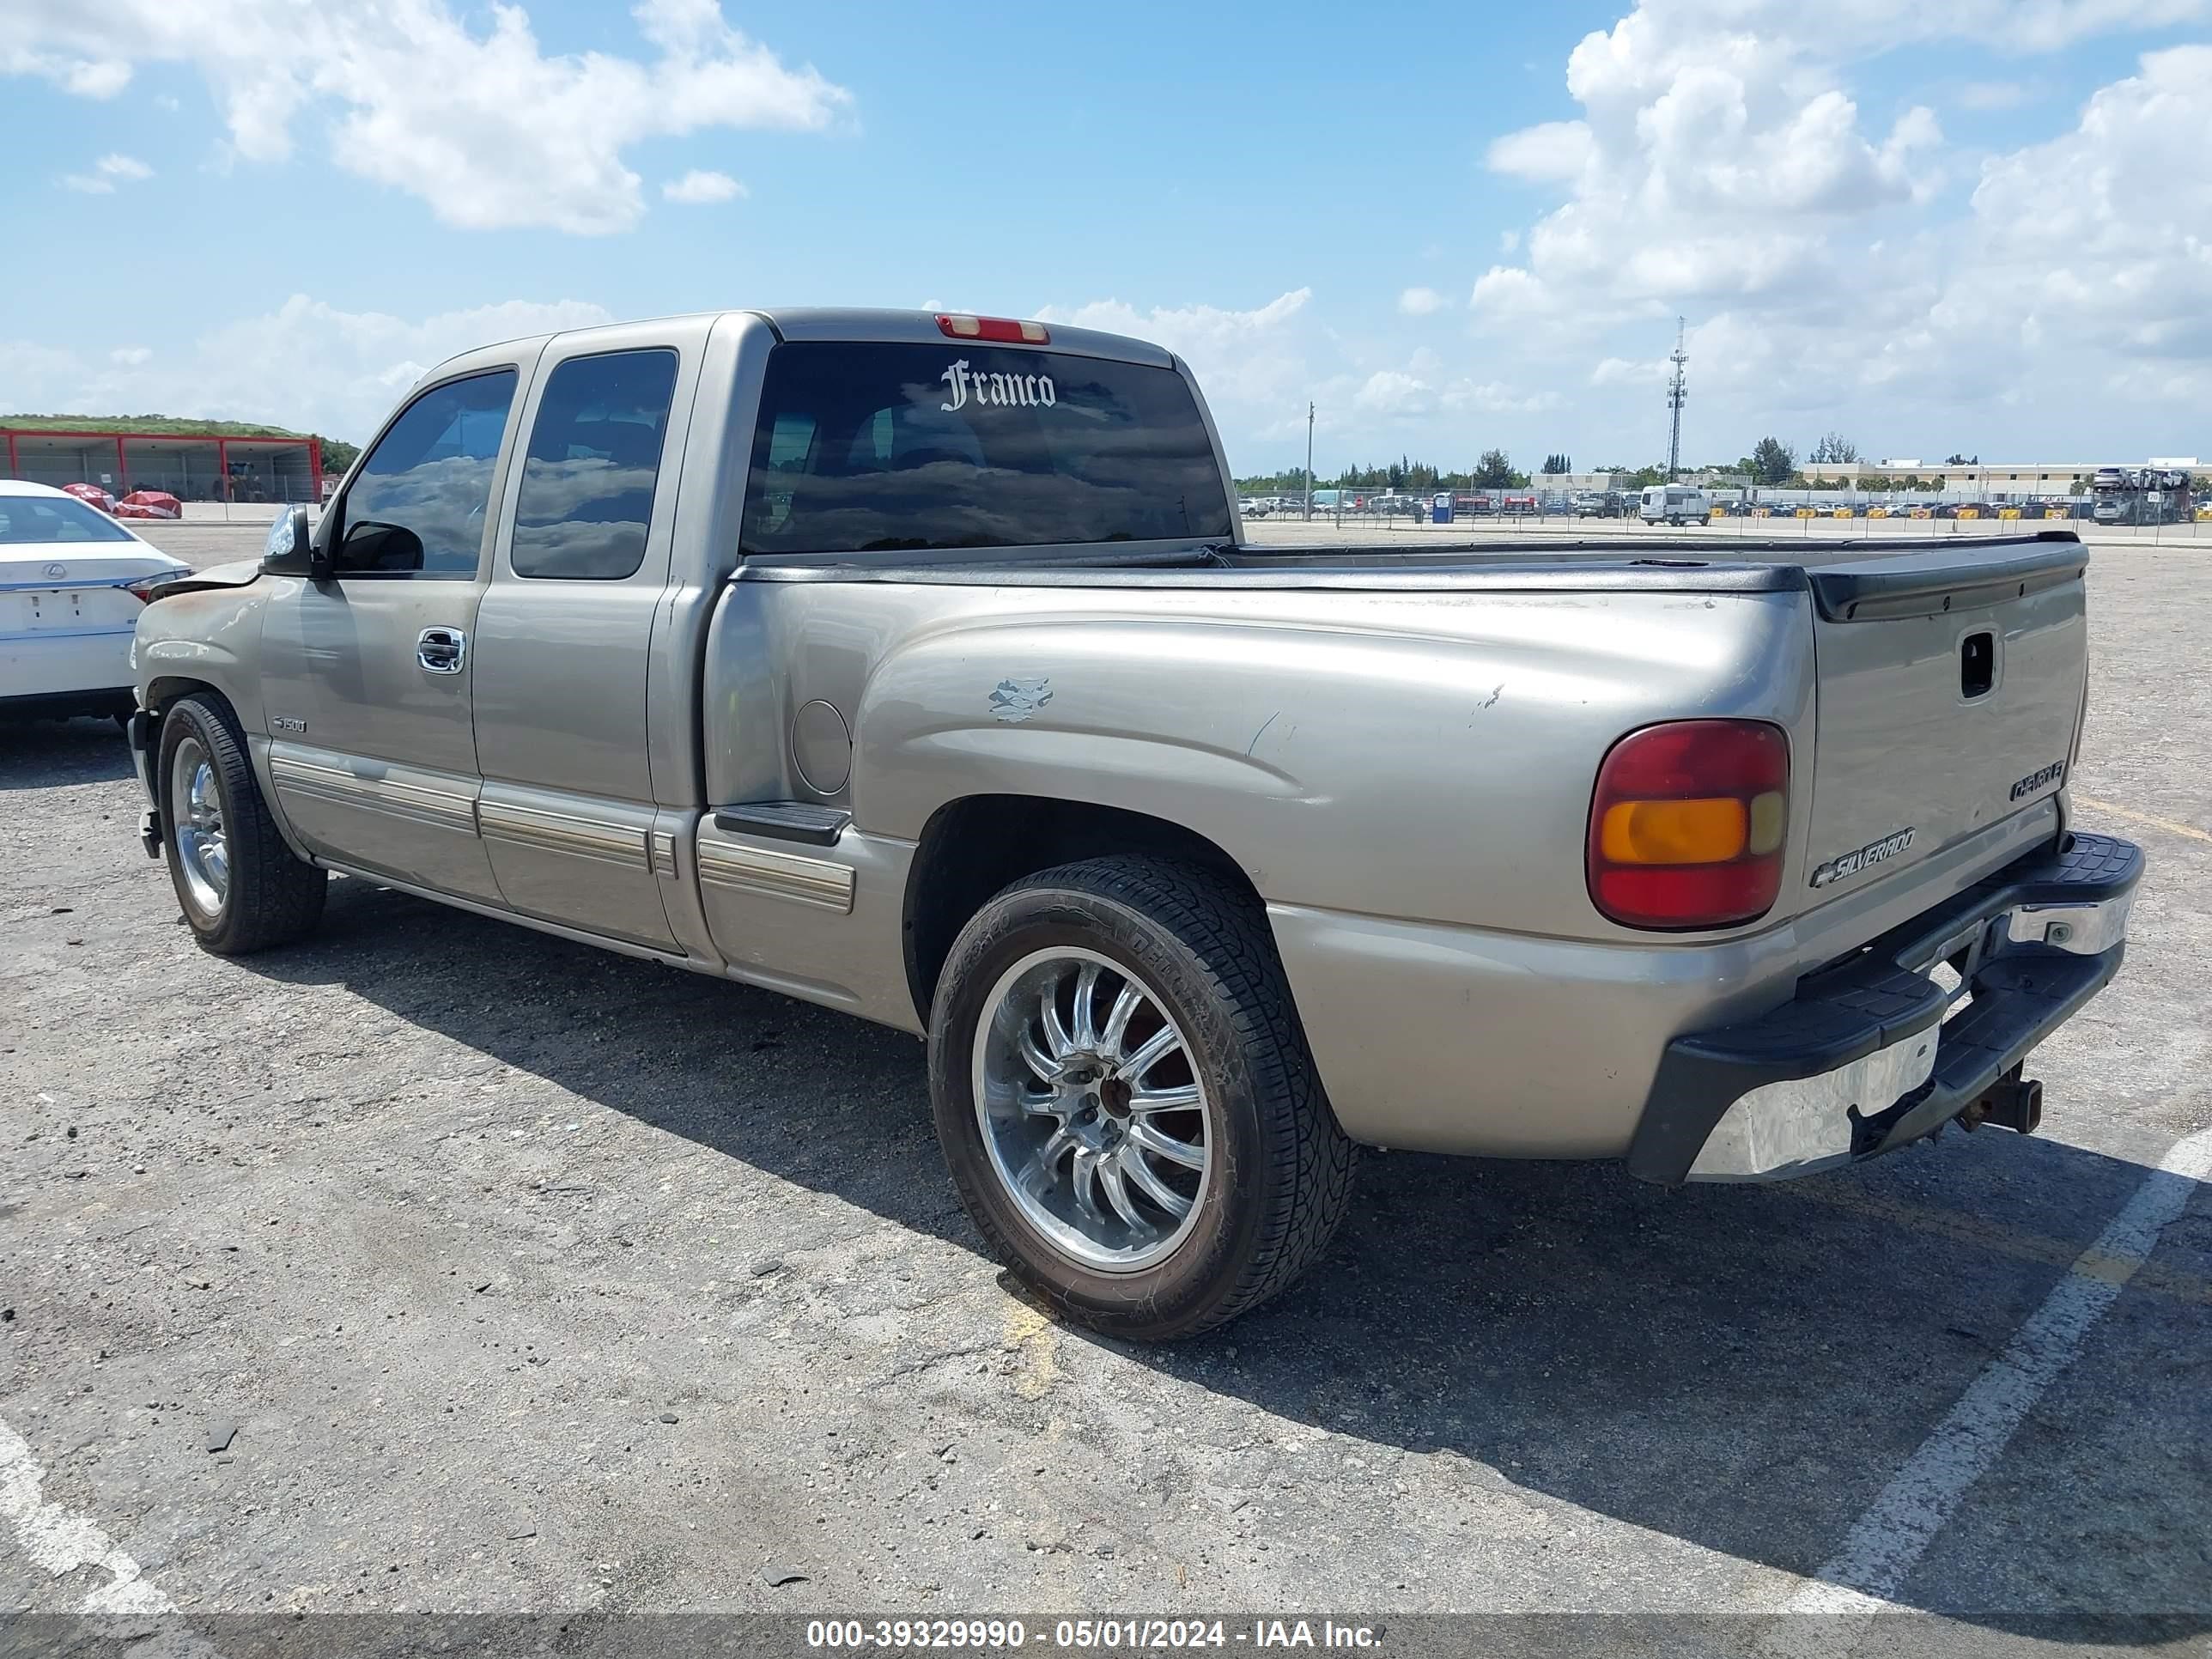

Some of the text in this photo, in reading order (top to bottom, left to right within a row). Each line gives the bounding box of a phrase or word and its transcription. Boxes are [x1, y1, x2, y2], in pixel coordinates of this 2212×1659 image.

[941, 359, 1056, 412] Franco
[283, 718, 307, 732] 1500
[1834, 828, 1916, 882] SILVERADO
